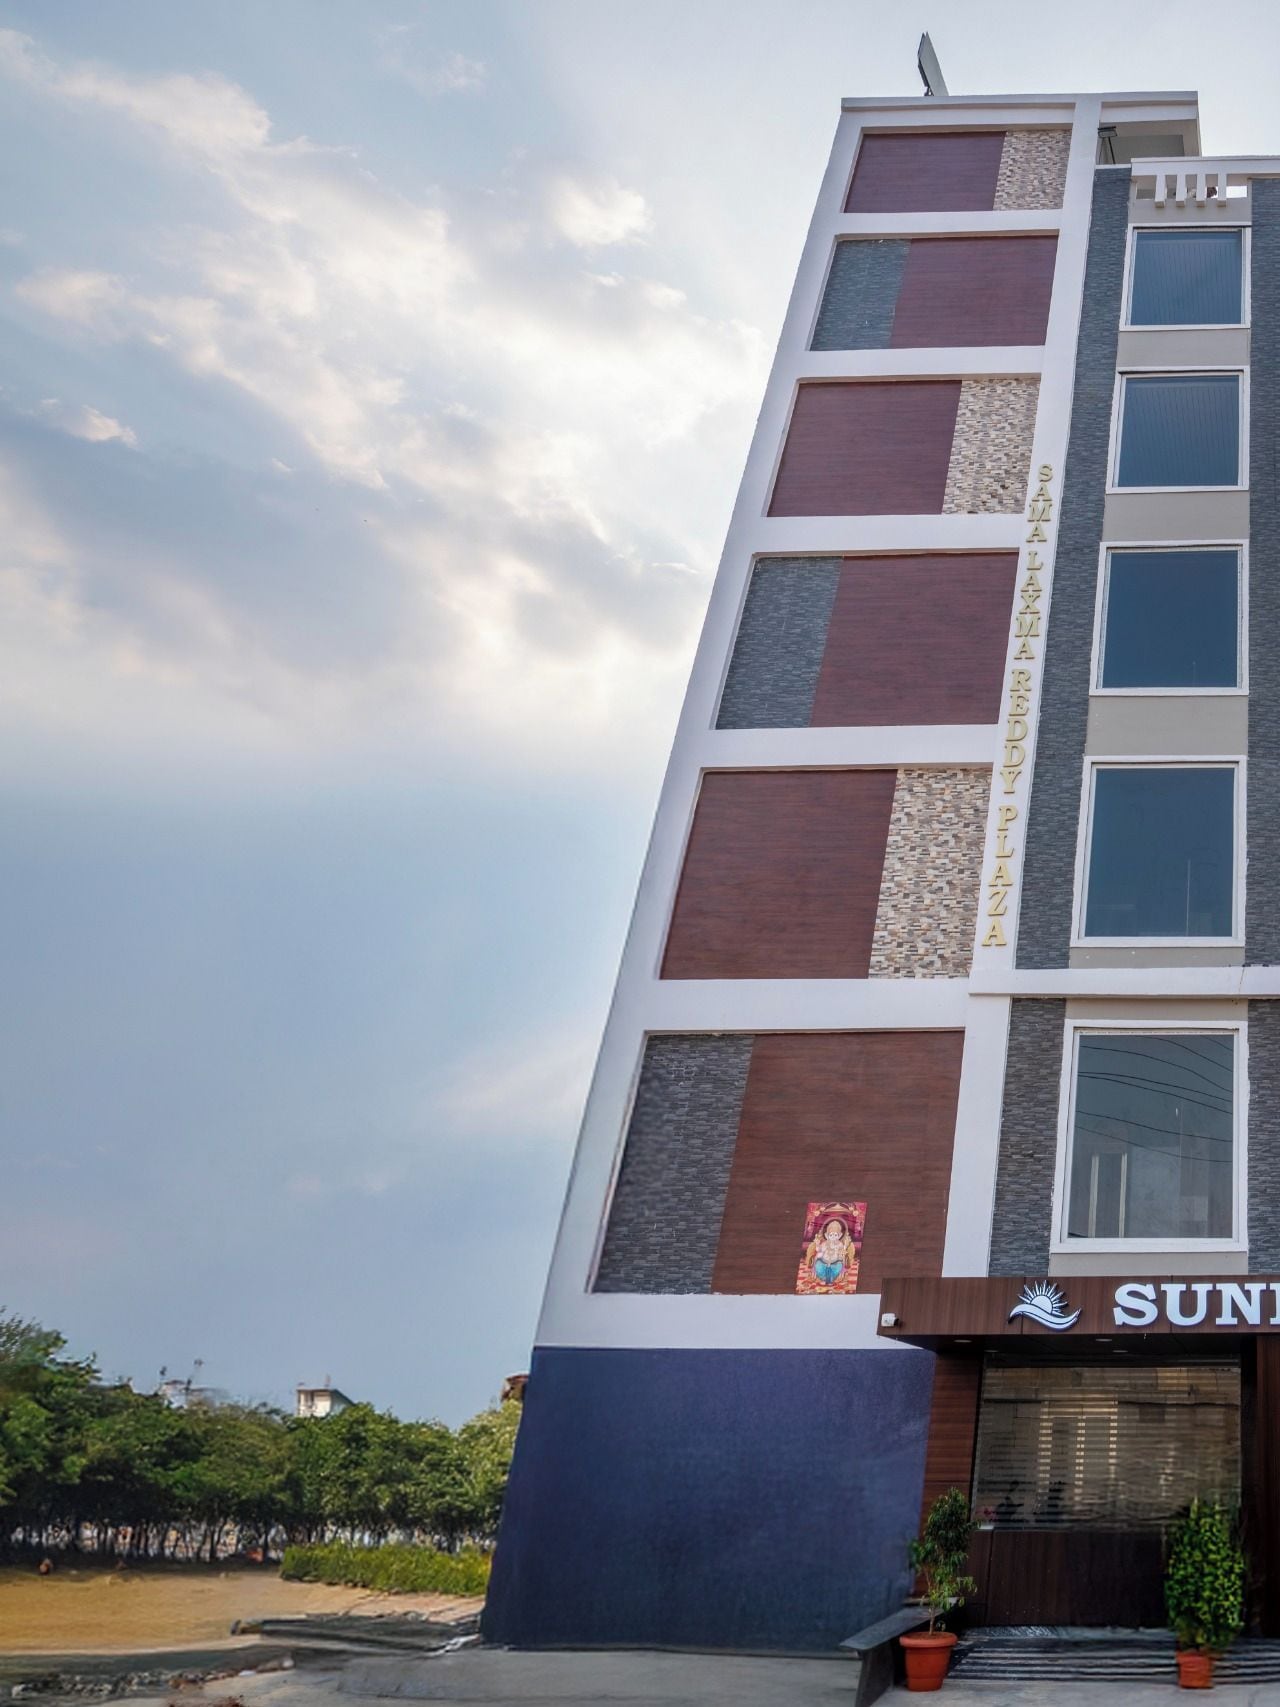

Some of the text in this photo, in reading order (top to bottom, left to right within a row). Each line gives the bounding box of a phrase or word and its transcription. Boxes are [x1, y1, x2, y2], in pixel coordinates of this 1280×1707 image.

[981, 463, 1053, 947] SAMA LAXMA REDDY PLAZA
